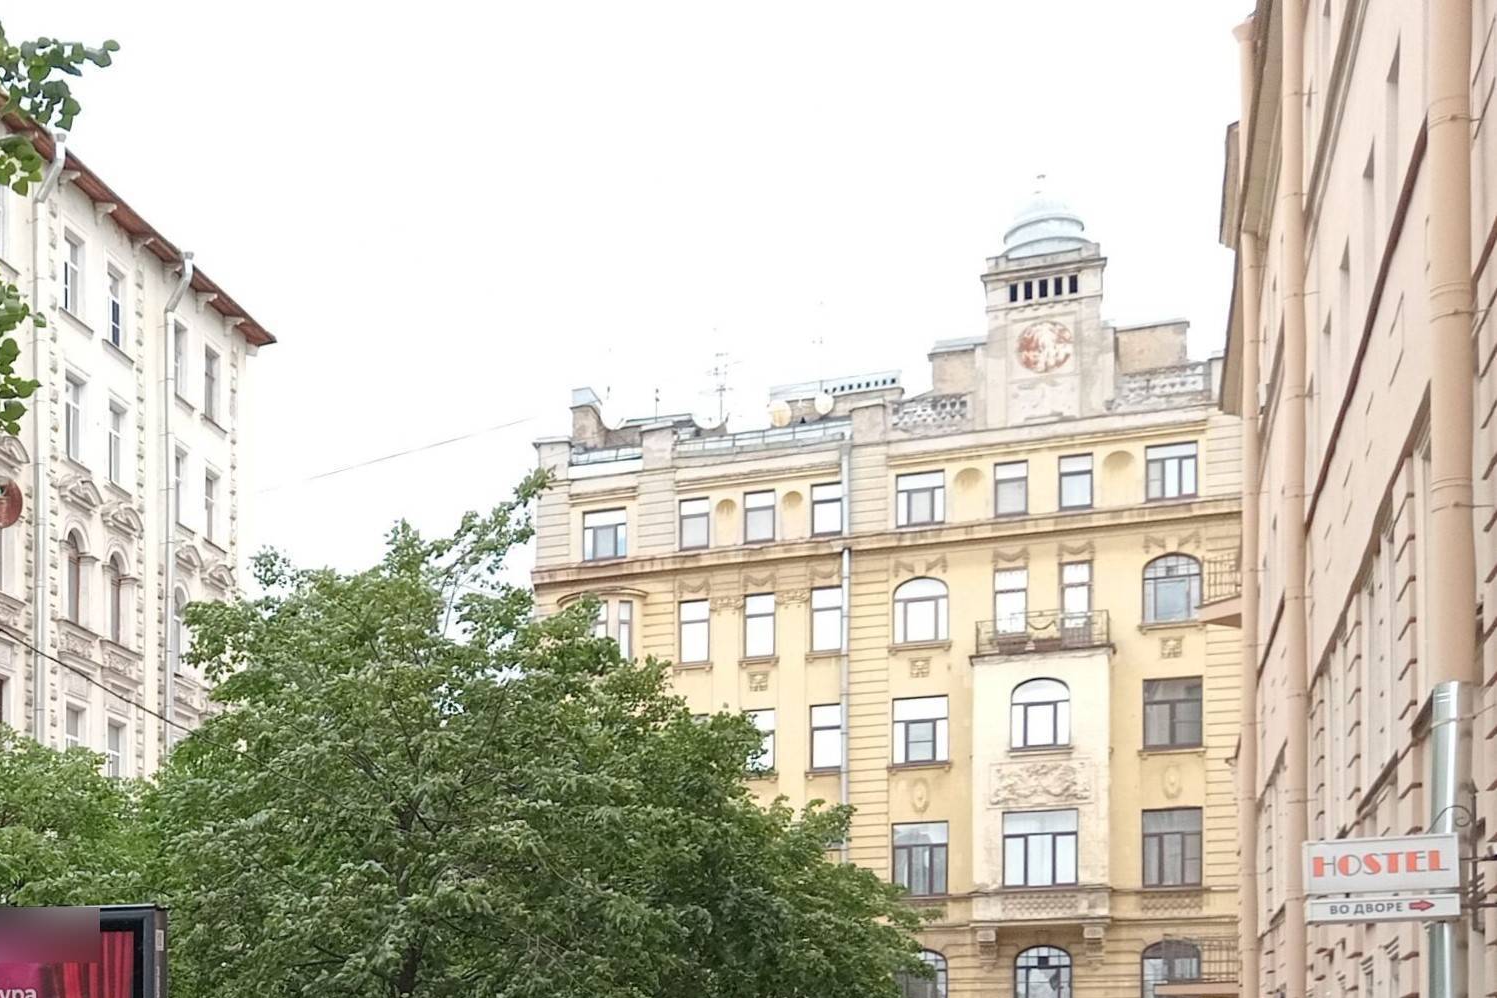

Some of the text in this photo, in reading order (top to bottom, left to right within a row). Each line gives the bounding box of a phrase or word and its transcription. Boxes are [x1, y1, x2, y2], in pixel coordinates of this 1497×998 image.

[1312, 850, 1450, 877] HOSTEL
[1330, 902, 1402, 915] ВО ДВОРЕ
